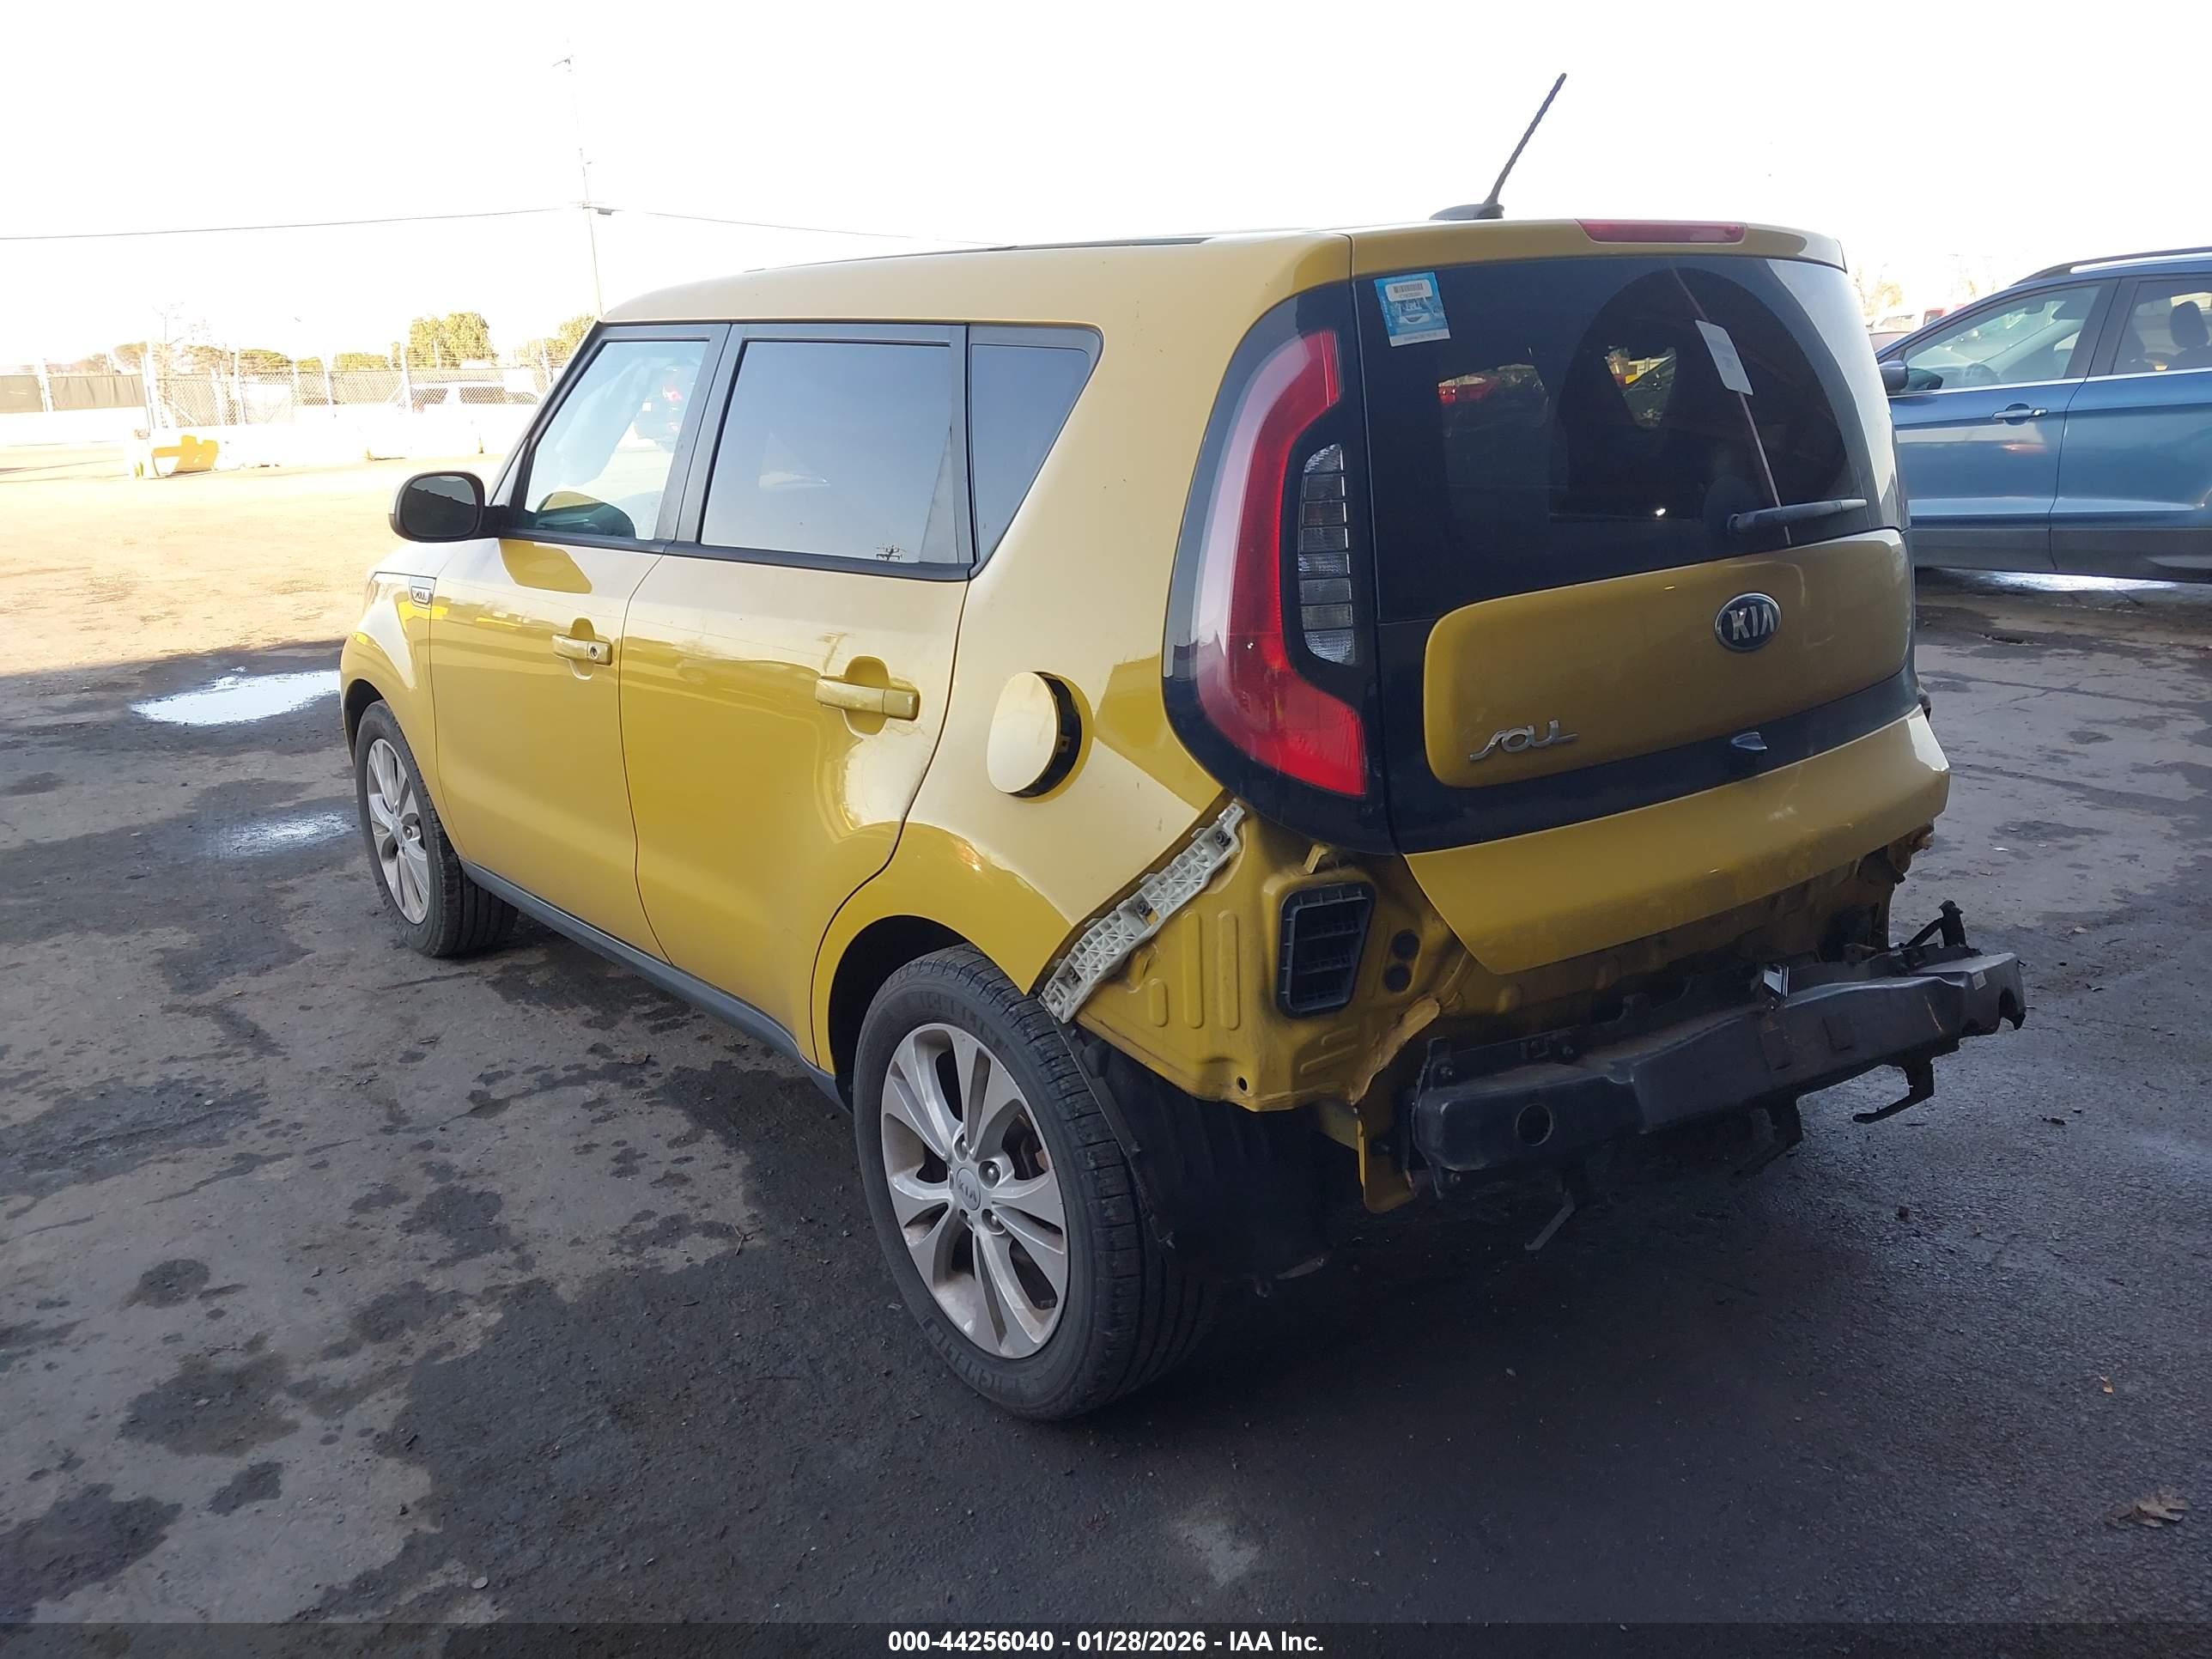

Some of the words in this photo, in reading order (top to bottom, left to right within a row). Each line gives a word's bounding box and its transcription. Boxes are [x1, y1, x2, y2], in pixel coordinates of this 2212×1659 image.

[1728, 603, 1775, 641] KIA
[1469, 720, 1579, 761] SOUL
[957, 1178, 977, 1203] KIA
